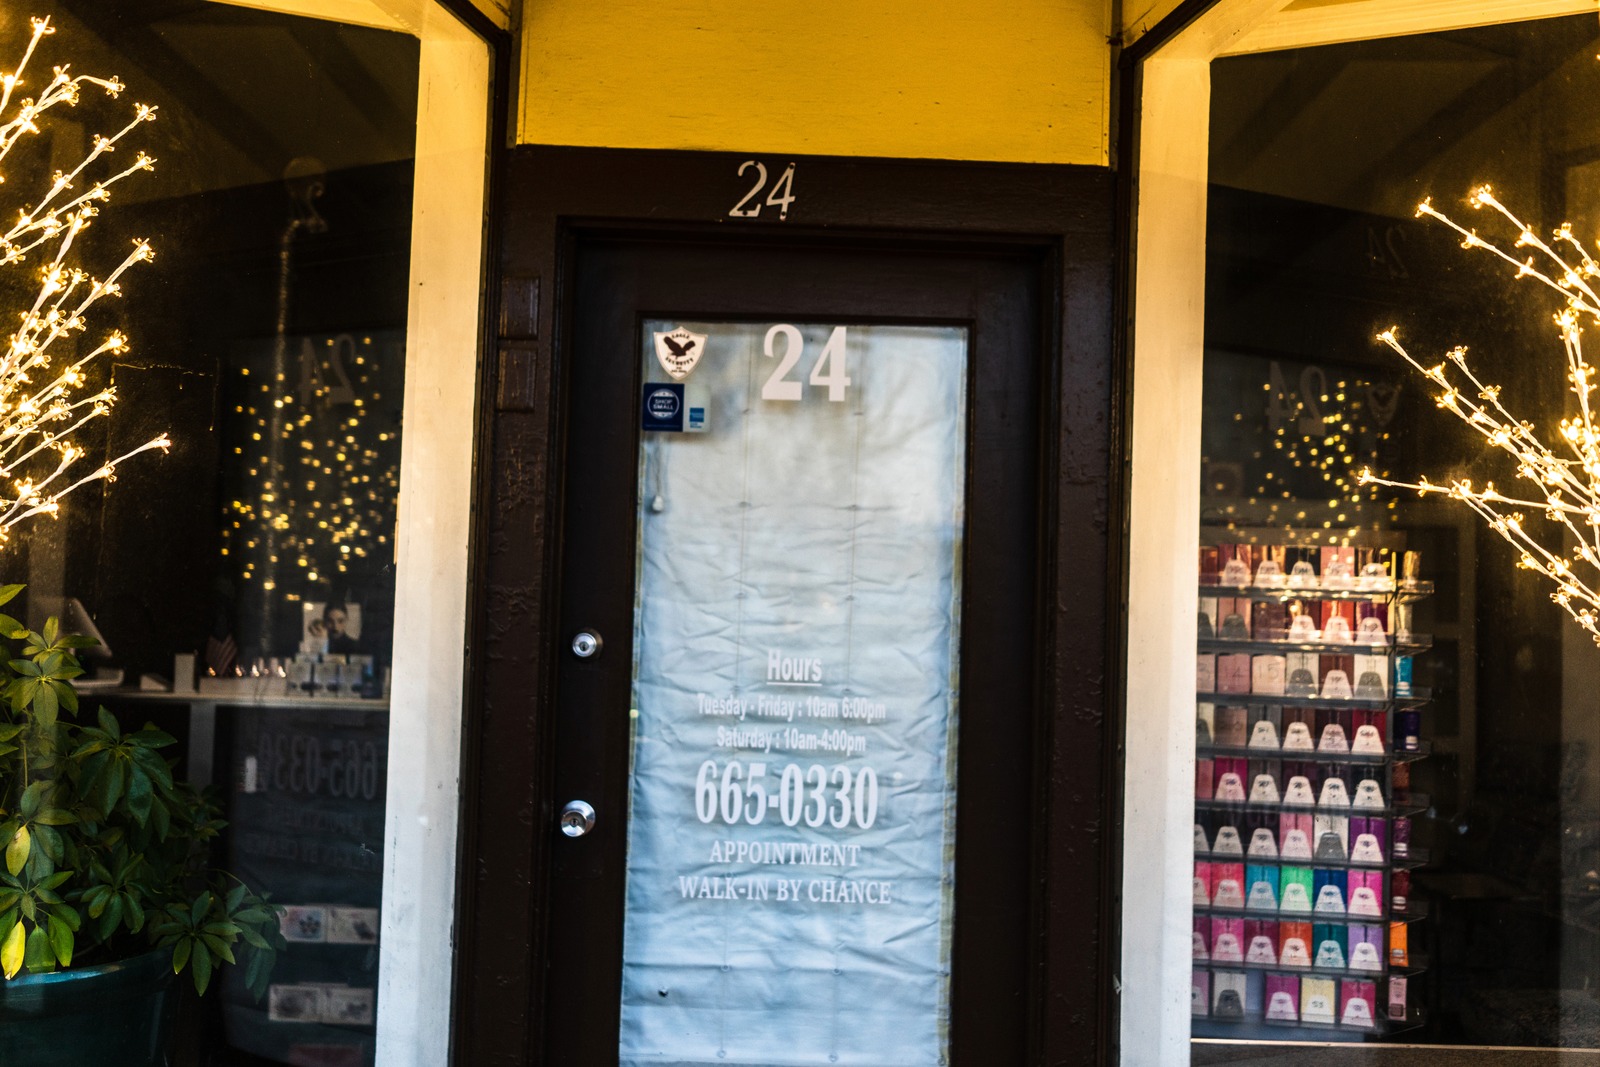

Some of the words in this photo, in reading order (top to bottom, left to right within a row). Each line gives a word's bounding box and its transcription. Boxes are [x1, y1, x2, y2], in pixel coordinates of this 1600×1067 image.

[729, 161, 796, 221] 24
[762, 324, 851, 402] 24
[766, 650, 823, 682] Hours
[697, 693, 746, 721] Tuesday
[757, 695, 796, 722] Friday
[805, 697, 838, 719] 10am
[841, 697, 887, 724] 6:00pm
[716, 725, 772, 753] Saturday
[783, 728, 867, 757] 10am-4:00pm
[695, 760, 879, 830] 665-0330
[709, 840, 862, 867] APPOINTMENT
[678, 875, 769, 901] WALK-IN
[776, 878, 803, 902] BY
[808, 880, 892, 905] CHANCE
